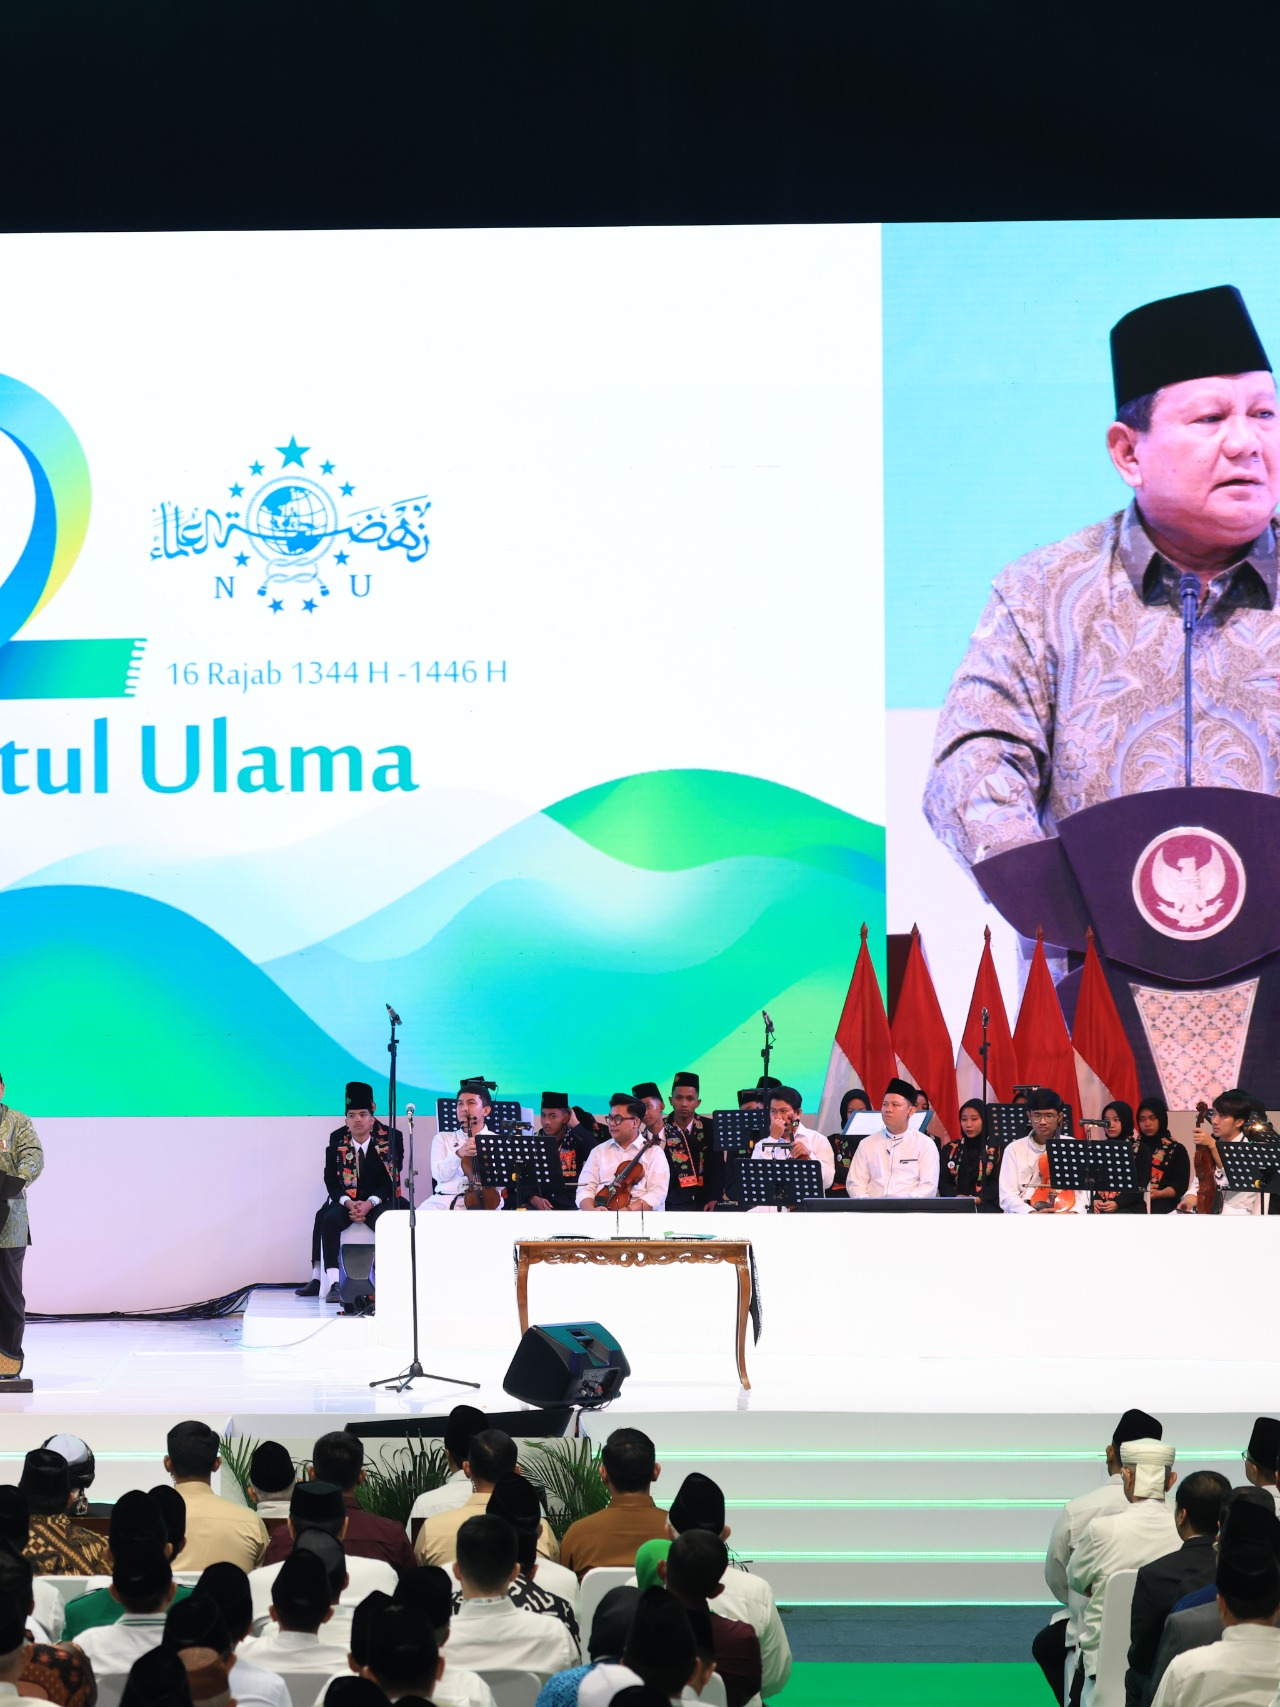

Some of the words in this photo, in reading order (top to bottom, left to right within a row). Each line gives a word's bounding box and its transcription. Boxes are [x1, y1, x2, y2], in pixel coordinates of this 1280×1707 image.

[214, 576, 236, 599] N
[349, 574, 373, 598] U
[167, 662, 200, 686] 16
[208, 660, 283, 694] Rajab
[292, 661, 360, 685] 1344
[369, 661, 390, 685] H
[487, 660, 509, 684] H
[140, 715, 422, 796] Ulama
